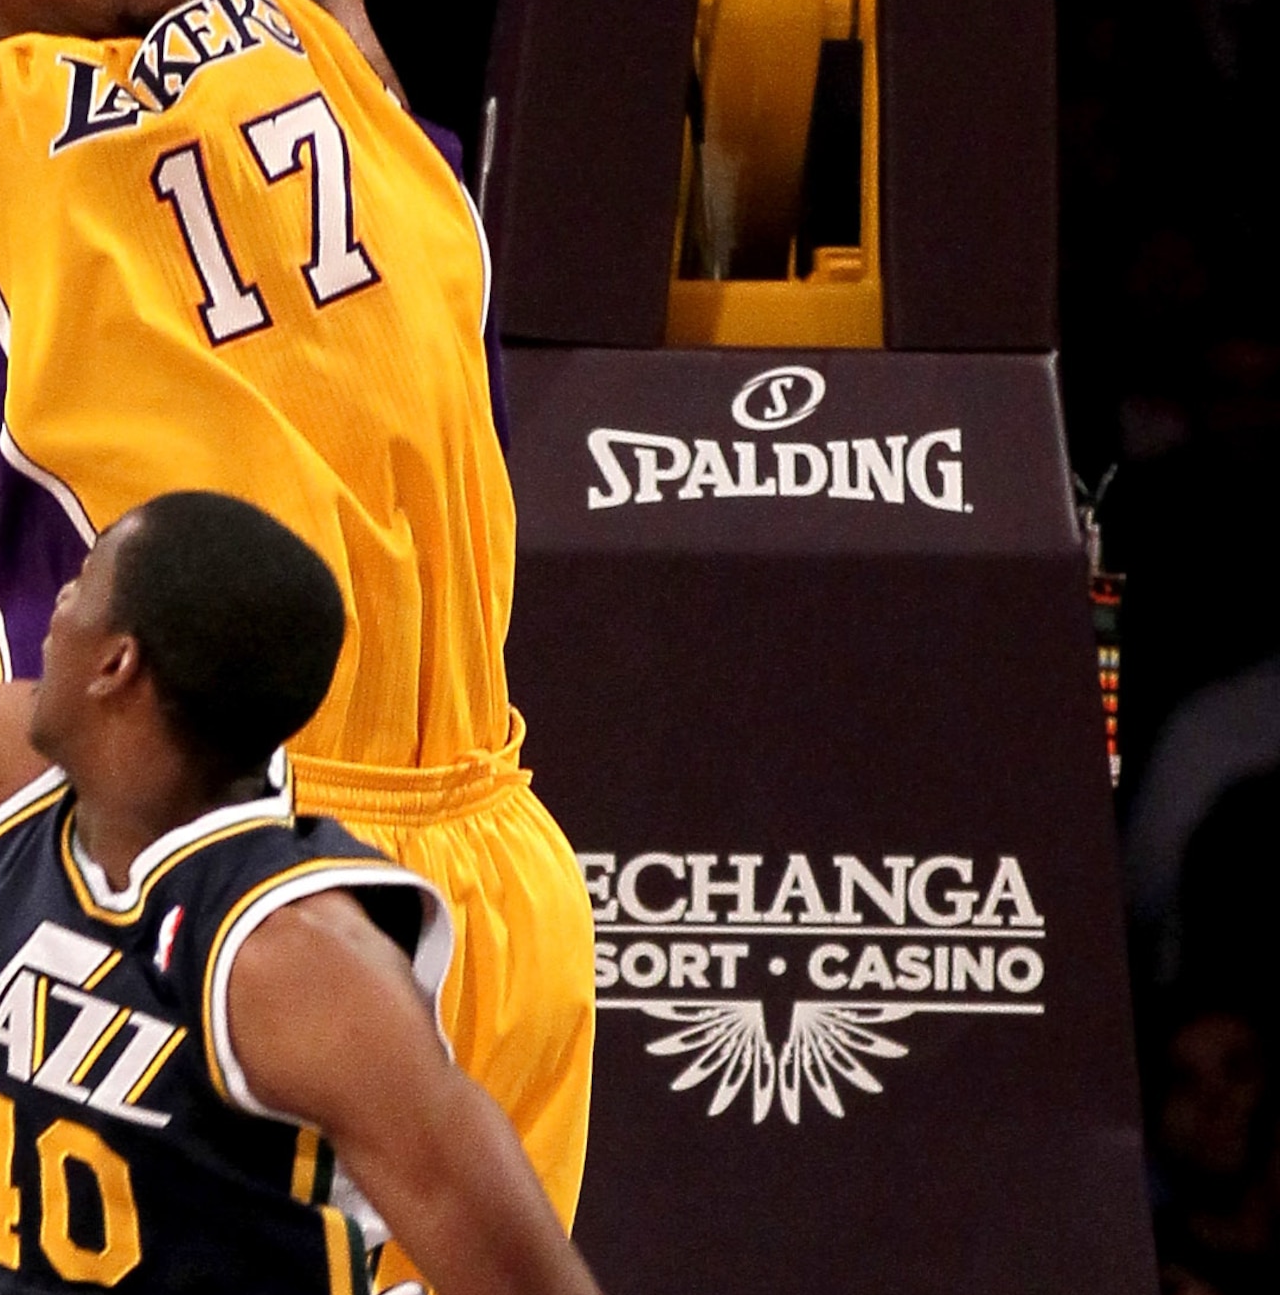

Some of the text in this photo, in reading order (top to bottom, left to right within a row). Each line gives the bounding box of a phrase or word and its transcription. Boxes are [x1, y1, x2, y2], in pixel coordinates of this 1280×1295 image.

[150, 90, 382, 348] 17
[587, 427, 964, 514] SPALDING
[577, 852, 1046, 927] ECHANGA
[594, 941, 1045, 993] SORT CASINO
